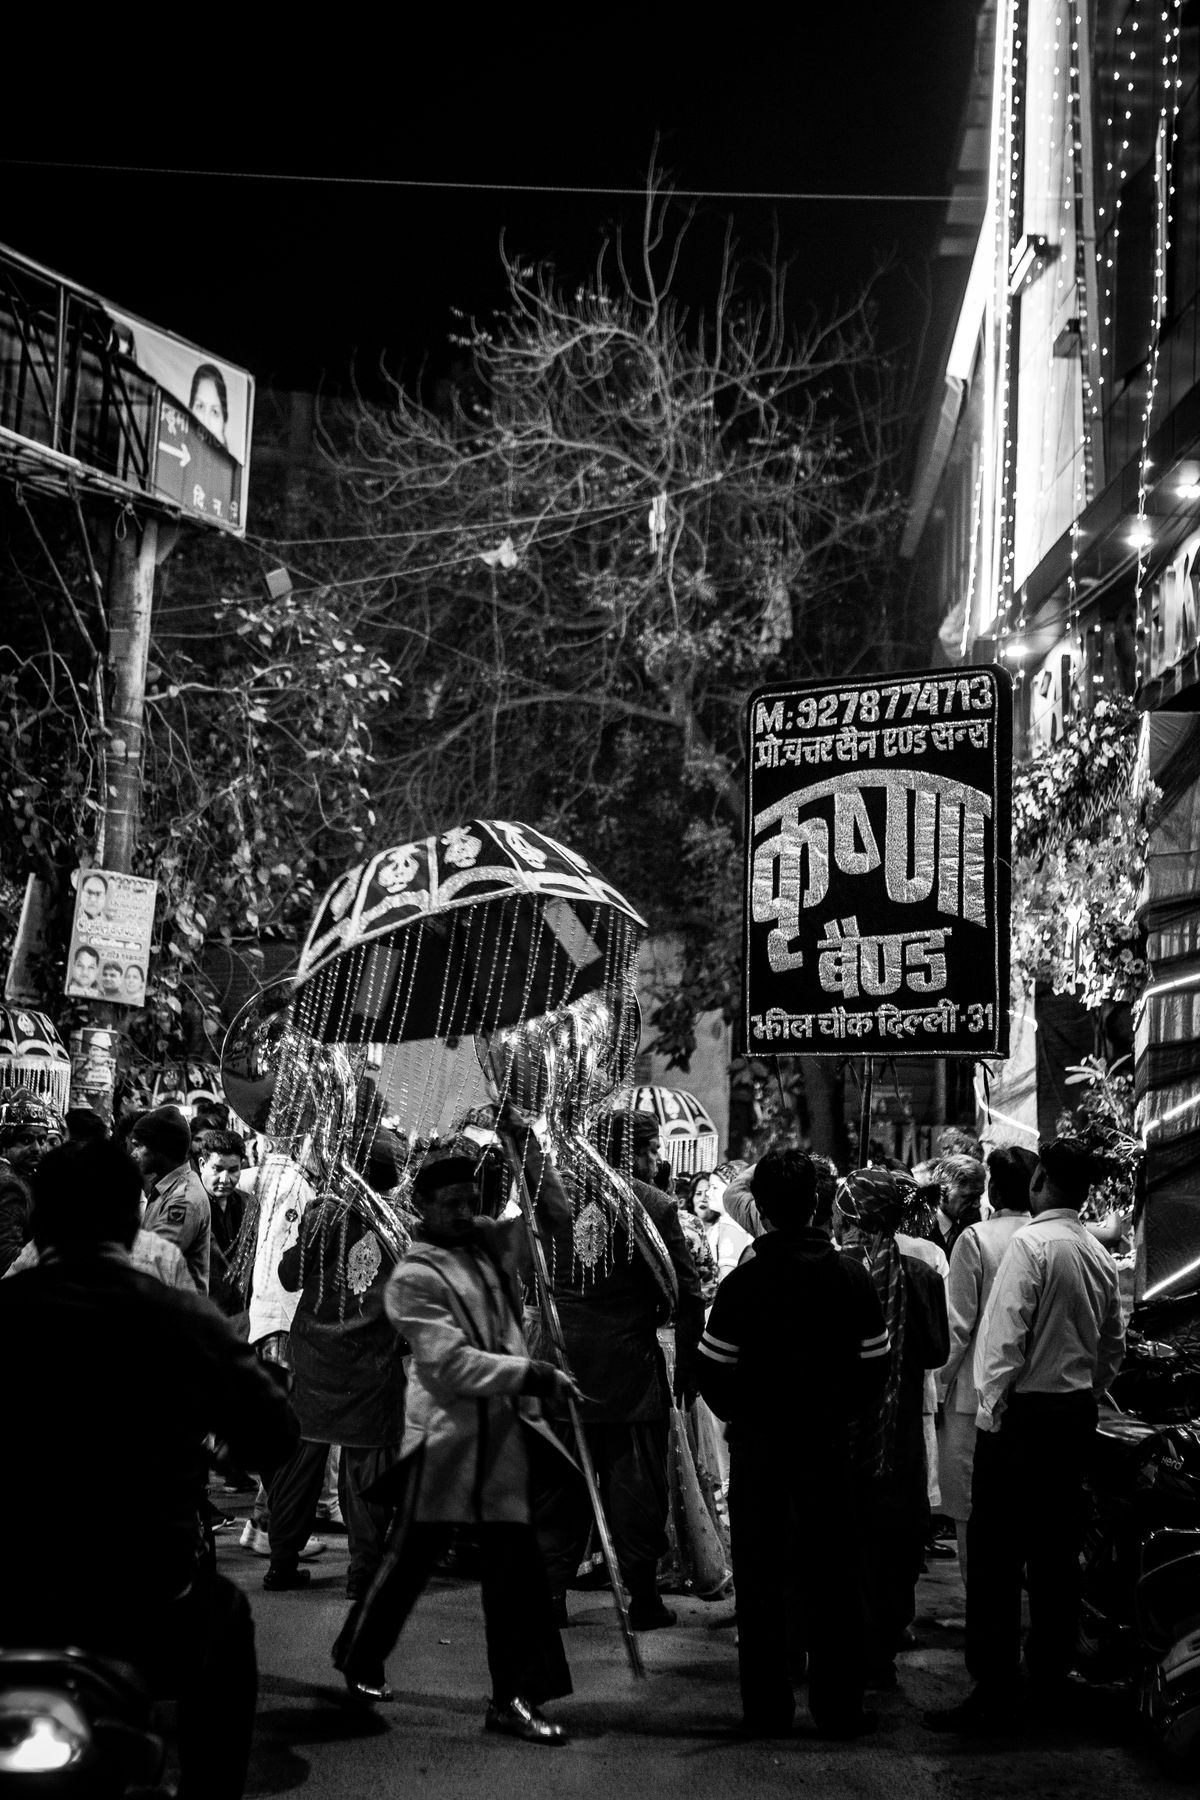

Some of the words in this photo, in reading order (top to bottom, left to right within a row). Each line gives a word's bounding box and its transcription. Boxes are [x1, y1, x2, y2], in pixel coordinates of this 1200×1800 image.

[882, 724, 931, 758] एण्ड
[931, 718, 993, 751] सन्स
[752, 769, 993, 973] कृष्णा
[817, 915, 953, 999] बैण्ड
[751, 1007, 817, 1041] झील
[817, 1006, 875, 1039] चौक
